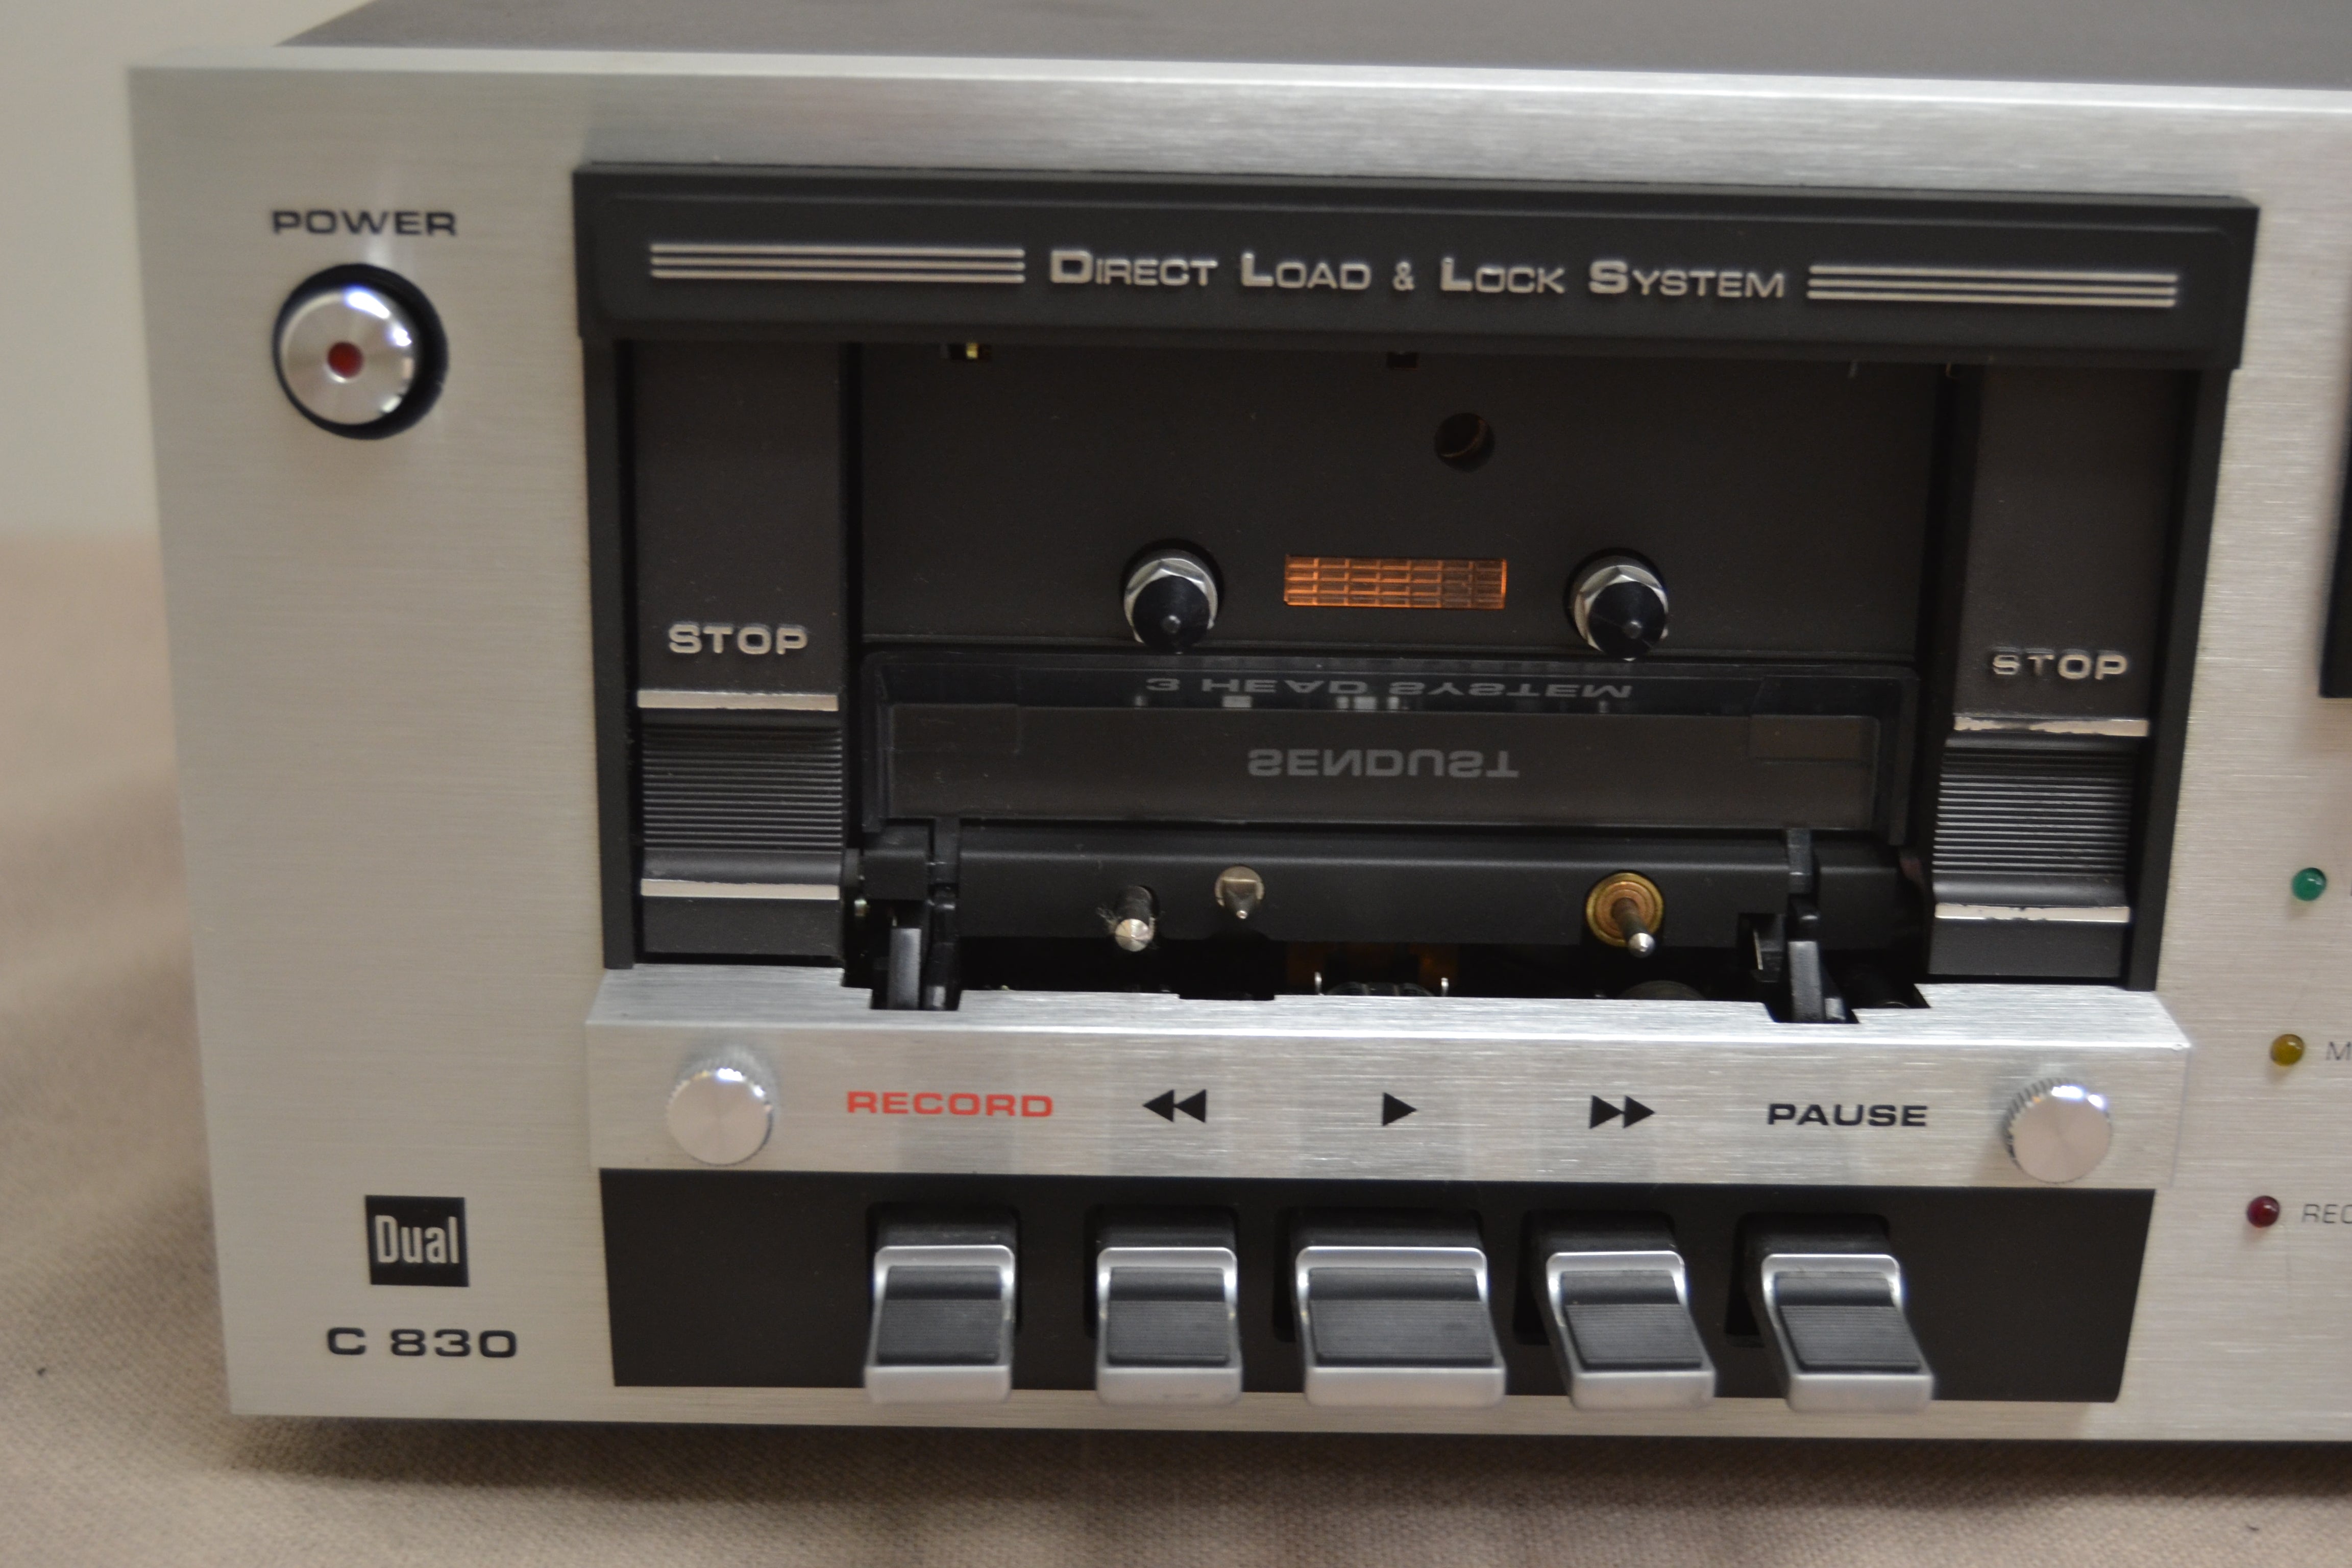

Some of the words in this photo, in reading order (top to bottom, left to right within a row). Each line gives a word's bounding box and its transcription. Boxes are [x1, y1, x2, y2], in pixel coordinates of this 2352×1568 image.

[272, 210, 457, 236] POWER
[1049, 249, 1219, 286] DIRECT
[1241, 252, 1371, 290] LOAD
[1393, 261, 1415, 291] &
[1440, 257, 1566, 294] LOCK
[1588, 260, 1786, 298] SYSTEM
[668, 621, 808, 655] STOP
[1992, 647, 2128, 680] STOP
[847, 1091, 1053, 1117] RECORD
[1768, 1103, 1928, 1126] PAUSE
[374, 1215, 459, 1263] Dual
[327, 1327, 366, 1356] C
[389, 1328, 517, 1358] 830
